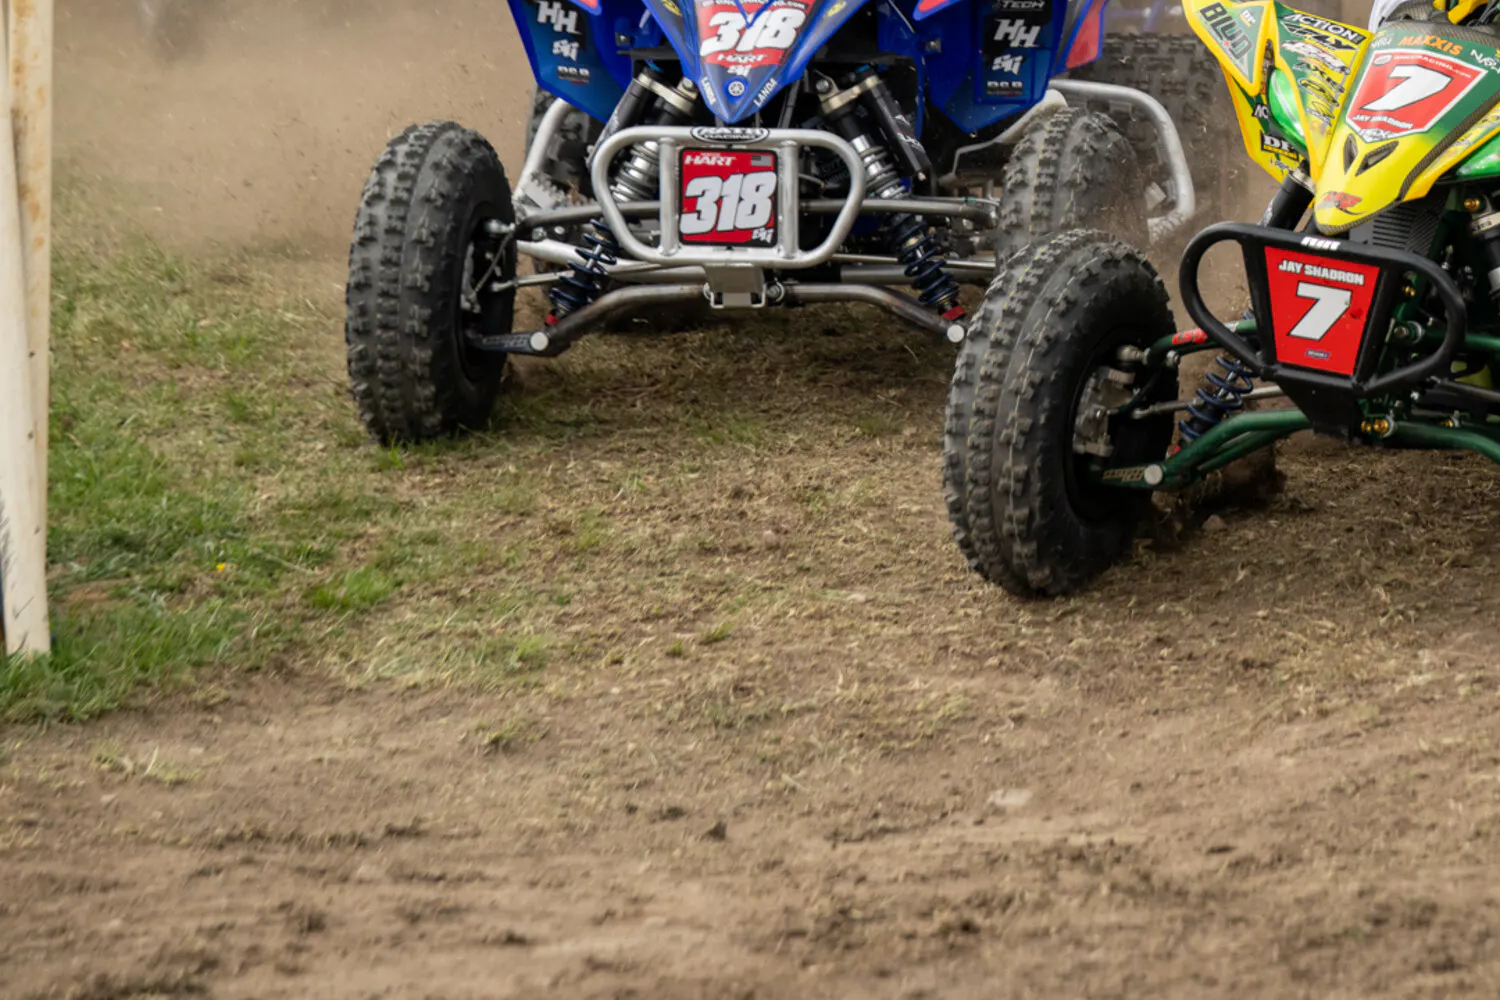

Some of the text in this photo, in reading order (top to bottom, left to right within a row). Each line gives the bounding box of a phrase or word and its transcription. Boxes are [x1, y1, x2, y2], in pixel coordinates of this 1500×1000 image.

[1001, 1, 1044, 9] TECH
[700, 7, 806, 57] 318
[1397, 34, 1464, 57] MAXXIS
[753, 78, 778, 108] LANDA
[1360, 64, 1454, 112] 7
[684, 154, 734, 167] HART
[680, 171, 778, 236] 318
[1279, 260, 1365, 286] JAY SHADRON
[1289, 282, 1353, 341] 7
